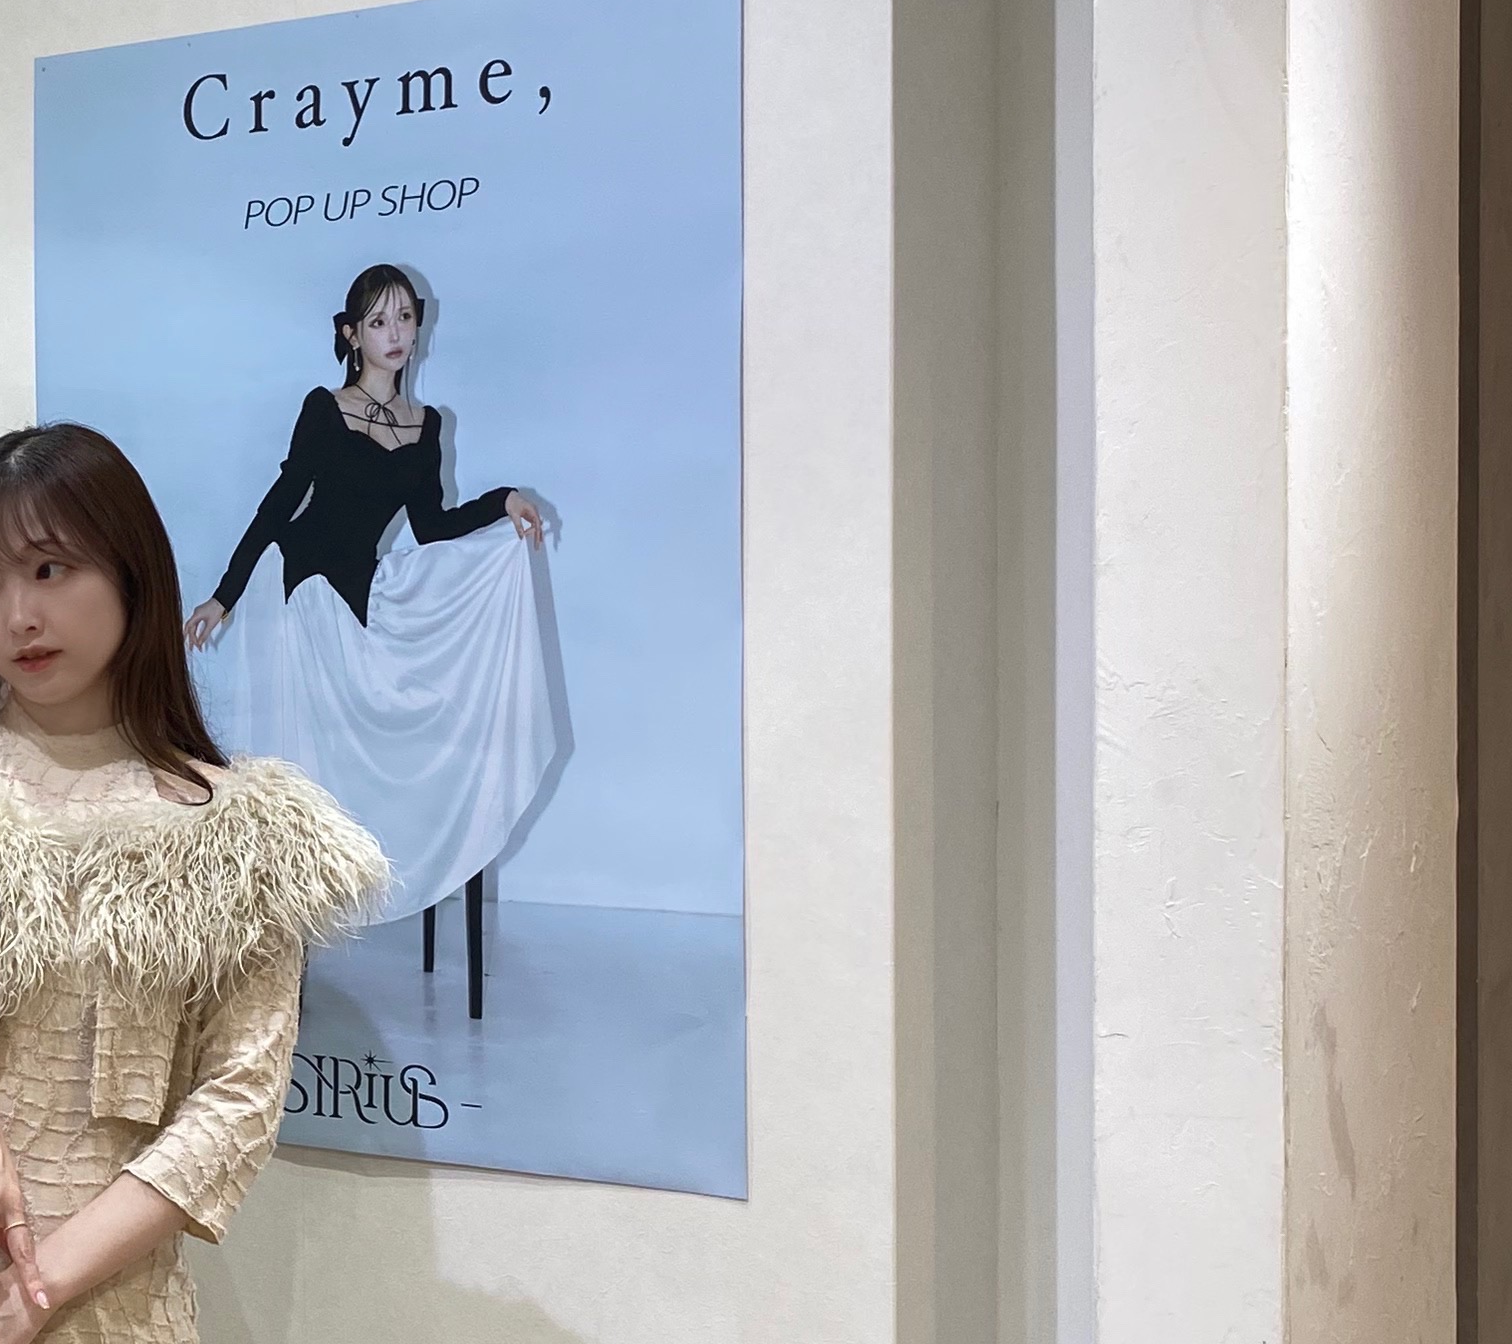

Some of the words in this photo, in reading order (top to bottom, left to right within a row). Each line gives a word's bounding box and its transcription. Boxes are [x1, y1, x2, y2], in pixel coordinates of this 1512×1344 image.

[182, 58, 552, 147] Crayme,
[243, 195, 316, 231] POP
[323, 189, 373, 223] UP
[377, 176, 481, 218] SHOP
